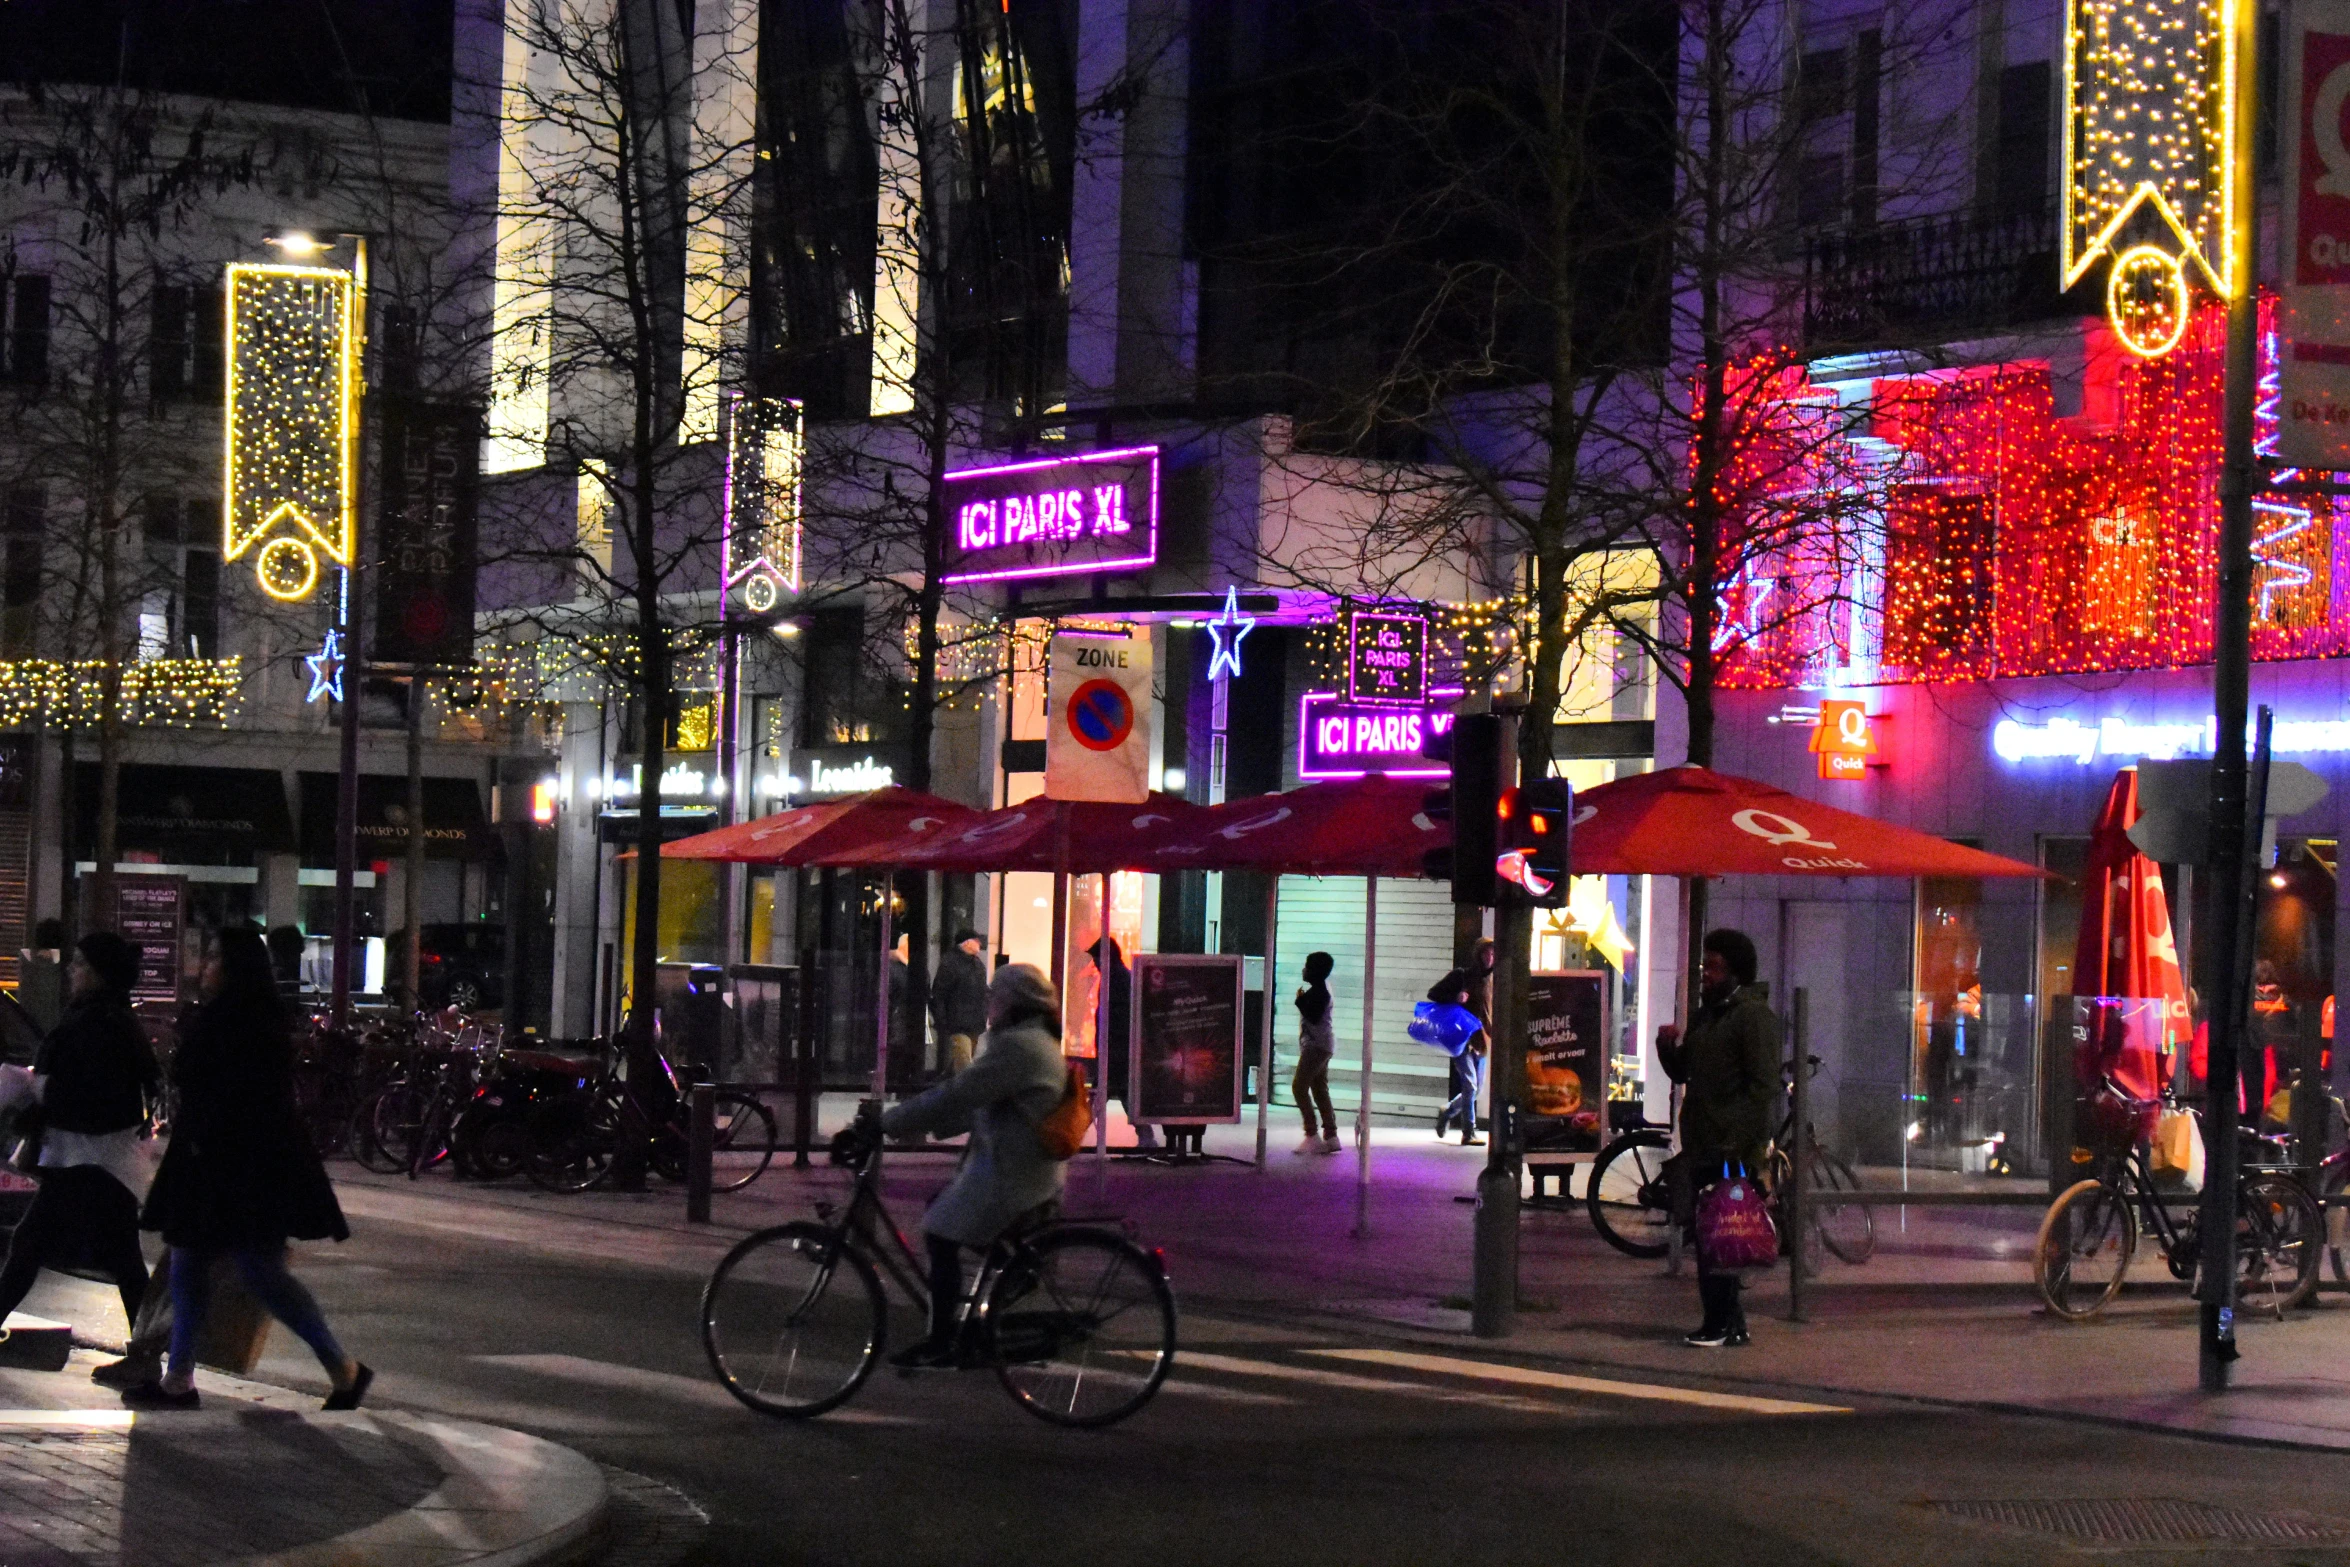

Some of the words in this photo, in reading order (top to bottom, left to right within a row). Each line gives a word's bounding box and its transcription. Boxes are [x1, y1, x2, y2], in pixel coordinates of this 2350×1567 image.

[960, 499, 997, 549] ICI
[1004, 489, 1083, 545] PARIS
[1092, 484, 1130, 537] XL
[1378, 632, 1401, 647] ICI
[1077, 647, 1129, 668] ZONE
[1365, 650, 1411, 667] PARIS
[1378, 670, 1398, 686] XL
[1317, 716, 1349, 754] ICI
[1356, 715, 1422, 753] PARIS
[1838, 707, 1867, 747] Q
[1832, 757, 1864, 771] Quick
[1732, 808, 1837, 849] Q
[1782, 856, 1870, 869] Quick
